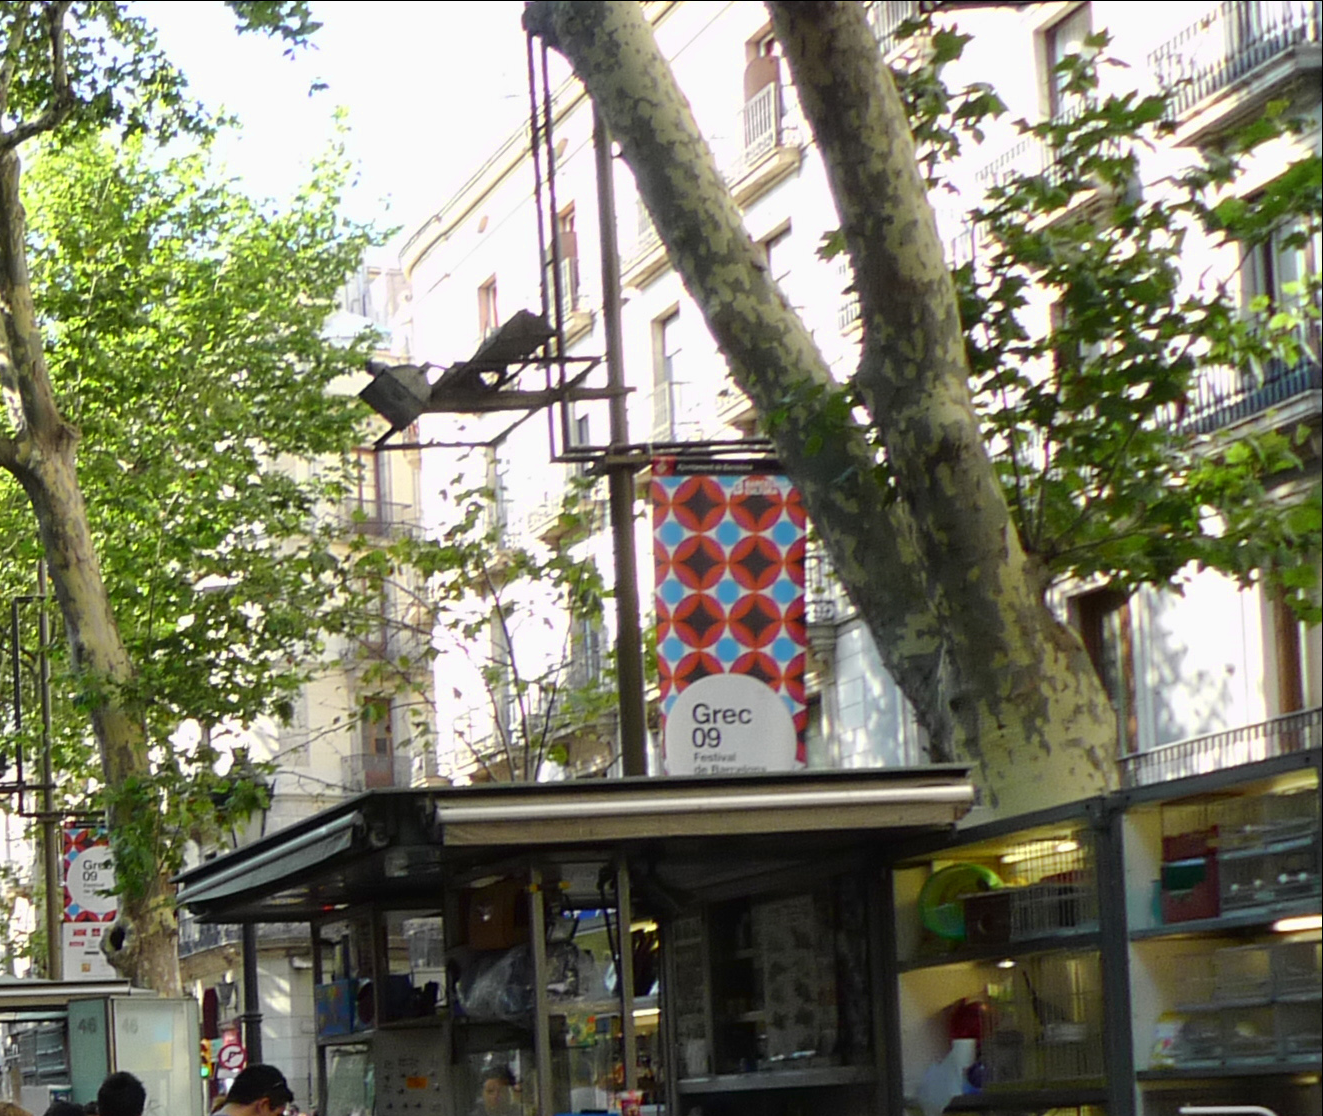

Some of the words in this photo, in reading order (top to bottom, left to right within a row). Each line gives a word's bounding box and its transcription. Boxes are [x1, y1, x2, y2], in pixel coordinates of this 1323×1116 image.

[692, 703, 752, 725] Grec
[692, 727, 722, 748] 09
[694, 752, 736, 762] Festival
[83, 860, 112, 871] Gre
[82, 871, 98, 882] 09
